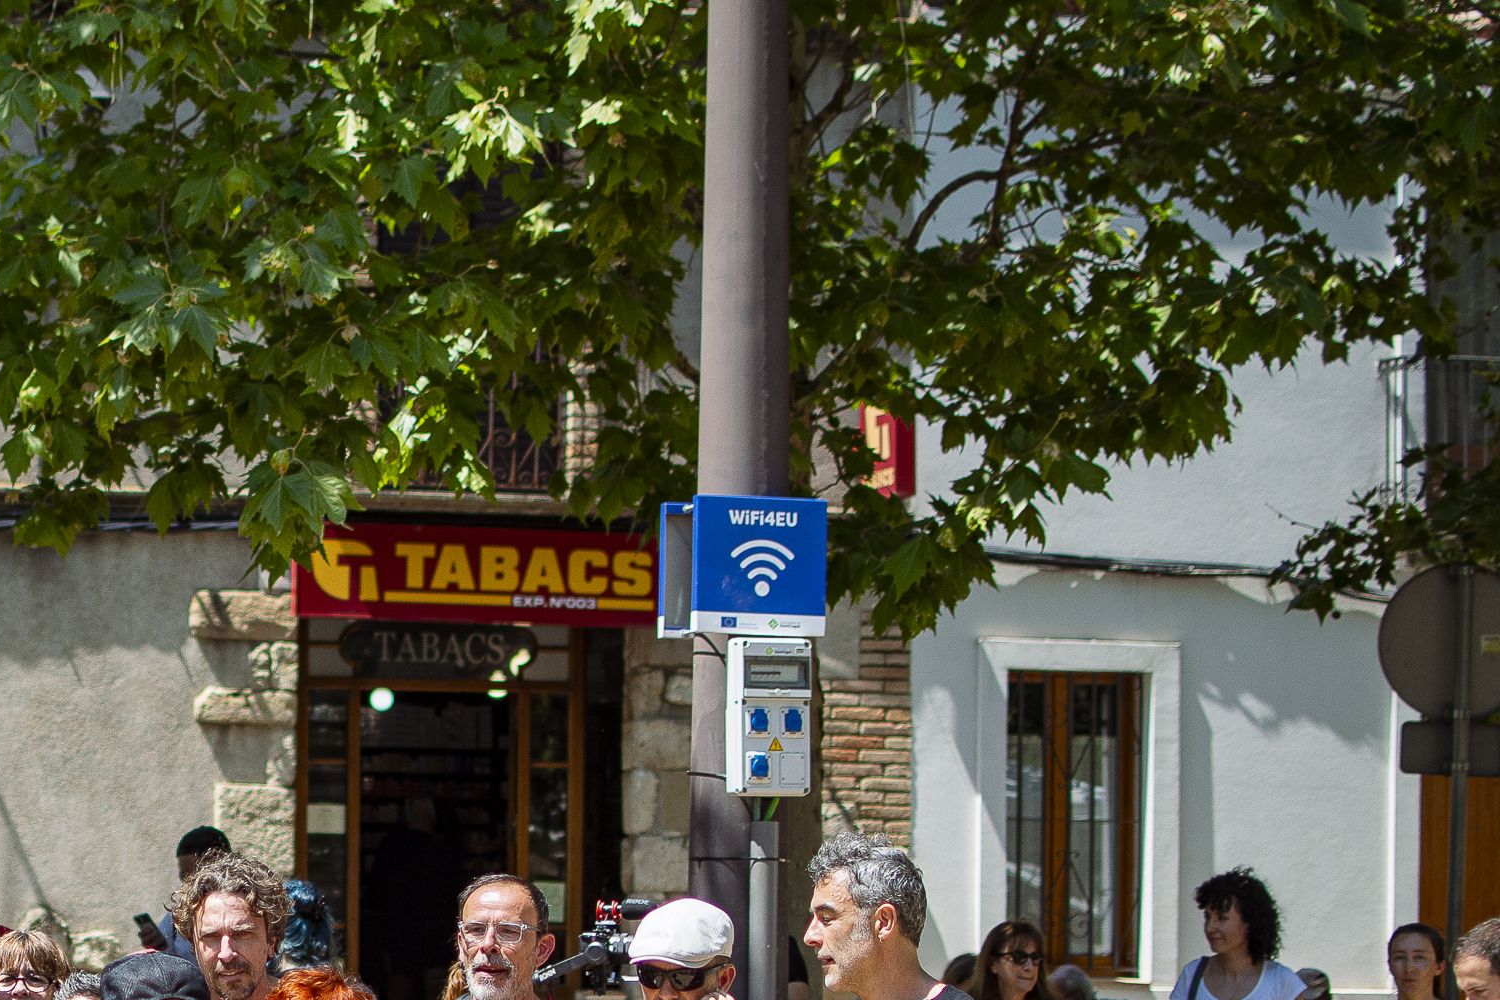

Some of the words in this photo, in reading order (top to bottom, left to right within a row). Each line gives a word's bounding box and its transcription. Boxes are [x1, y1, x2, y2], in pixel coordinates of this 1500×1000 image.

[728, 509, 799, 528] WiFi4EU
[395, 541, 654, 598] TABACS
[373, 630, 506, 666] TABACS
